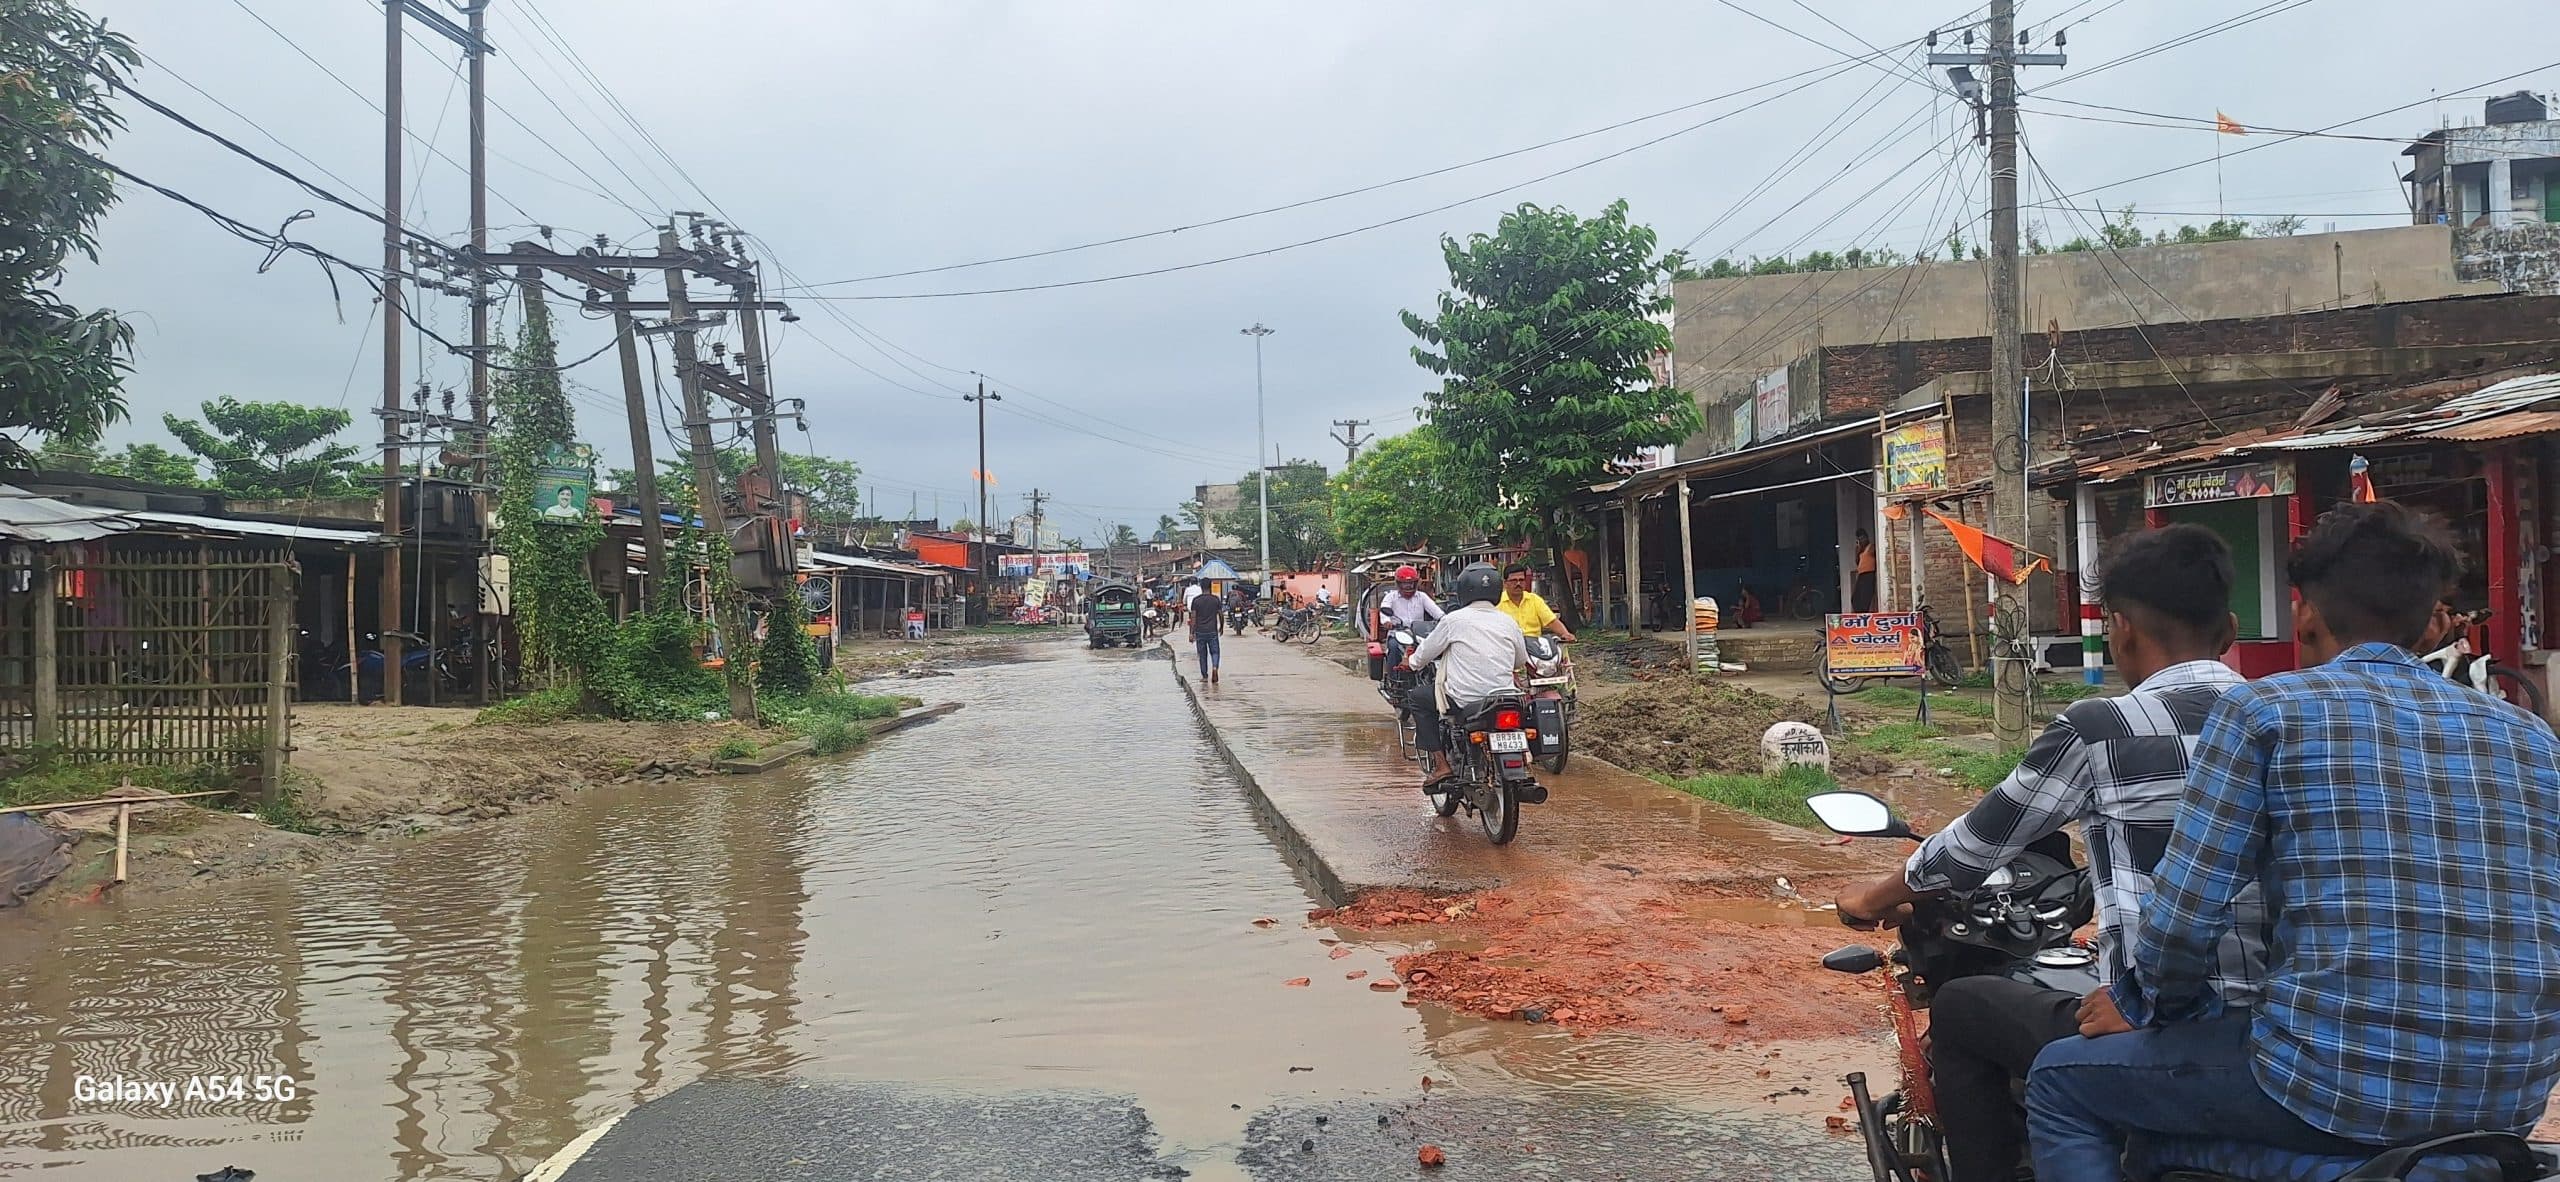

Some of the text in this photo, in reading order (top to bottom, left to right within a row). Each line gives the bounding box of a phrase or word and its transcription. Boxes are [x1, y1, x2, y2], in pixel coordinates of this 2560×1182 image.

[1844, 612, 1918, 632] माँ दुर्गा
[1850, 631, 1902, 645] ज्वेलर्स
